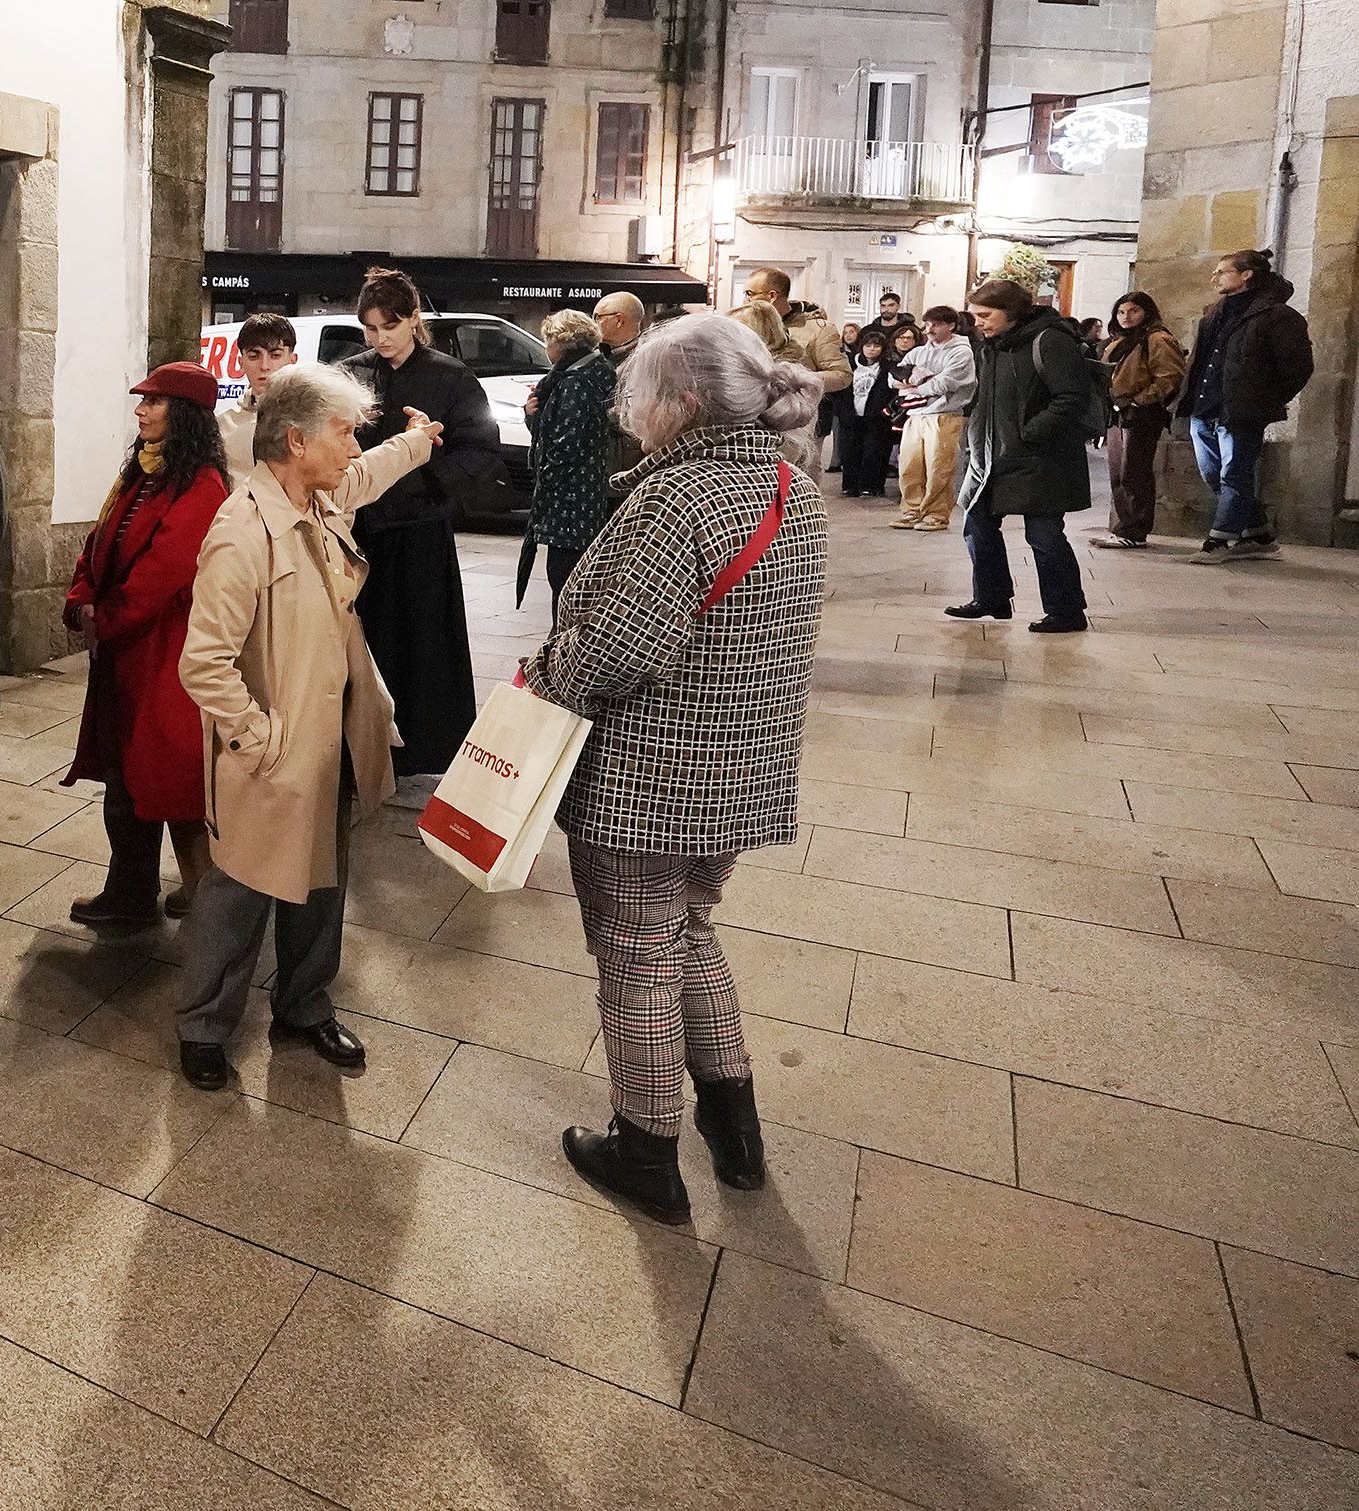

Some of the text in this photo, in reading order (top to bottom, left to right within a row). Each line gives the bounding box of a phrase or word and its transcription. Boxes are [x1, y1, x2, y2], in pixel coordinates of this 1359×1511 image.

[212, 275, 250, 288] CAMPÁS
[503, 287, 602, 298] RESTAURANTE ASADOR
